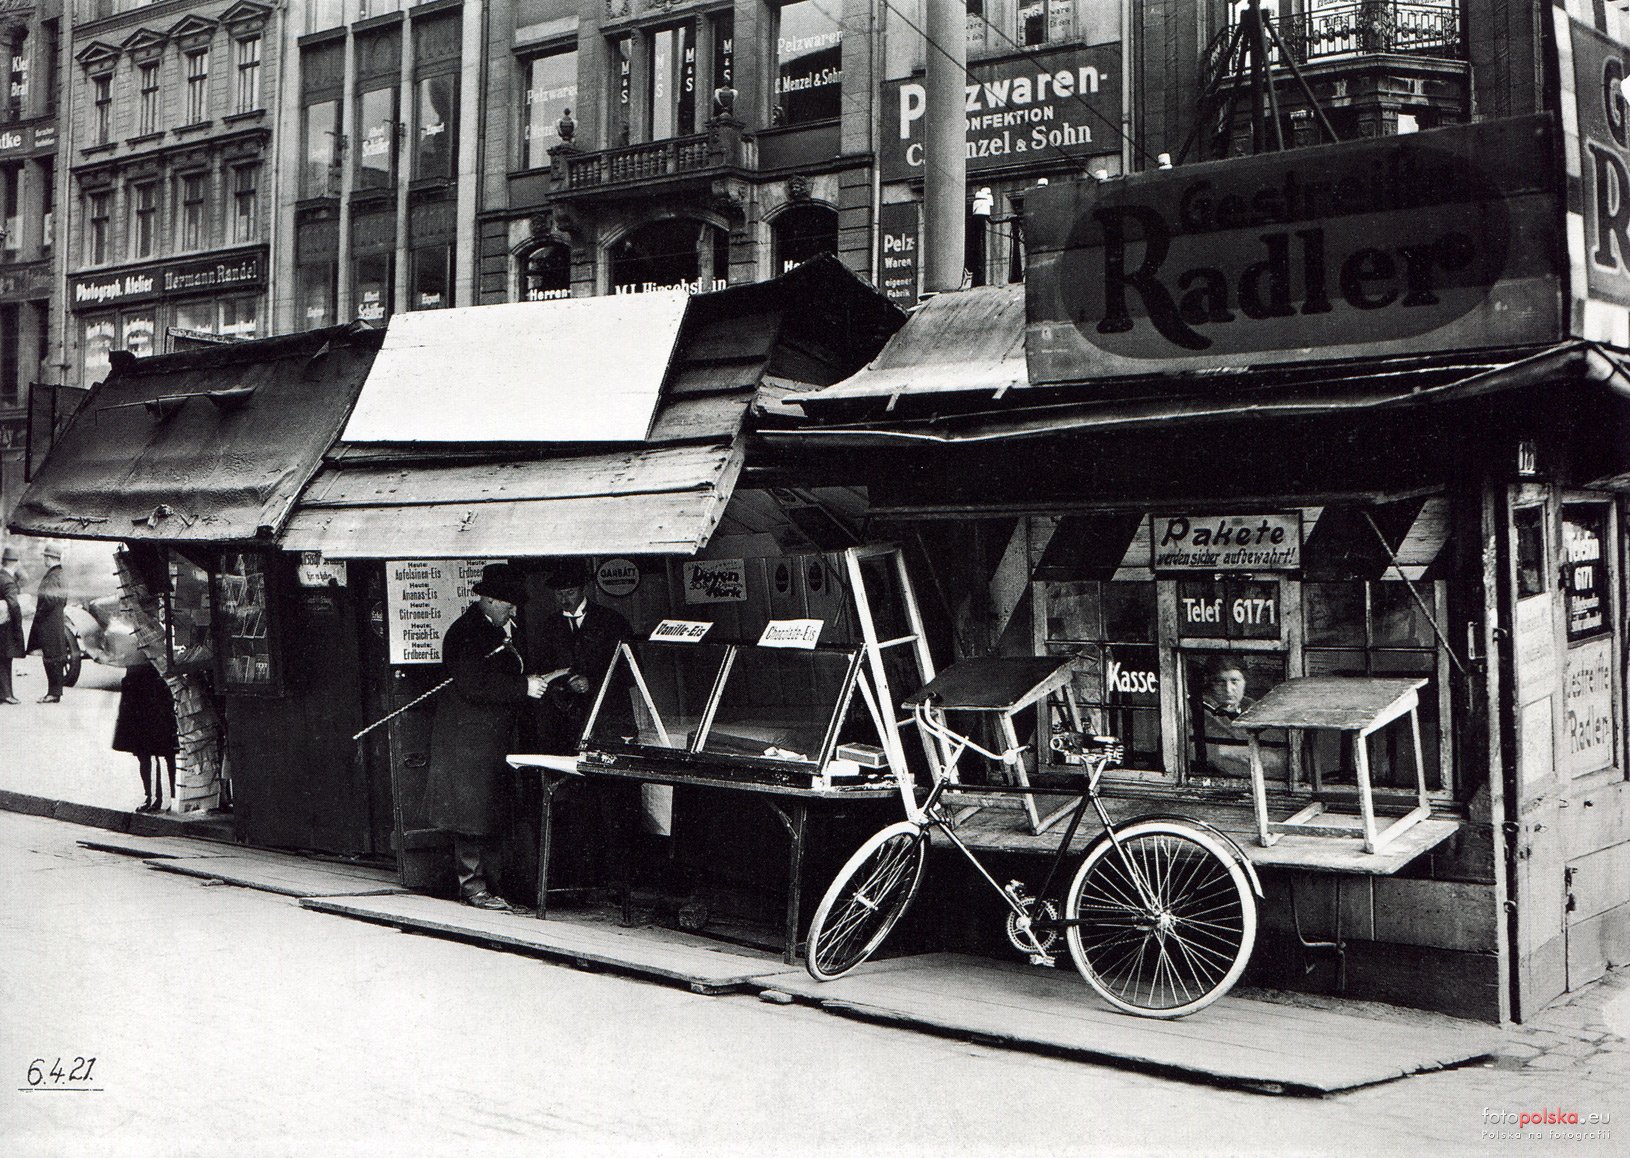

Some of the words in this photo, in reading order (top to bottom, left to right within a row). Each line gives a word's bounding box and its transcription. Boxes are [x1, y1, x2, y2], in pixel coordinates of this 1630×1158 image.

[814, 73, 821, 87] &
[900, 66, 1107, 139] Pzwaren-
[1015, 139, 1027, 153] &
[1031, 122, 1093, 150] Sohn
[885, 257, 911, 268] Waren
[165, 268, 215, 290] Hermann
[217, 260, 257, 283] Randel
[1092, 204, 1475, 349] Radler
[76, 277, 123, 303] Photograph.
[125, 274, 154, 295] Atelier
[885, 278, 912, 288] eigener
[887, 289, 910, 298] Fabrik
[1161, 518, 1285, 546] Pakete
[1157, 549, 1189, 565] werden
[1189, 549, 1220, 567] sicher
[1223, 548, 1296, 565] aufbewahrt!
[395, 567, 441, 580] Apfelsinen-Eis
[402, 588, 438, 600] Ananas-Eis
[399, 608, 442, 620] Citronen-Eis
[1183, 598, 1222, 623] Telef
[1233, 598, 1275, 624] 6171
[403, 628, 440, 640] Pfirsich-Eis.
[656, 623, 705, 637] Vanille-Eis
[403, 648, 441, 660] Erdbeer-Eis.
[1108, 661, 1158, 693] Kasse
